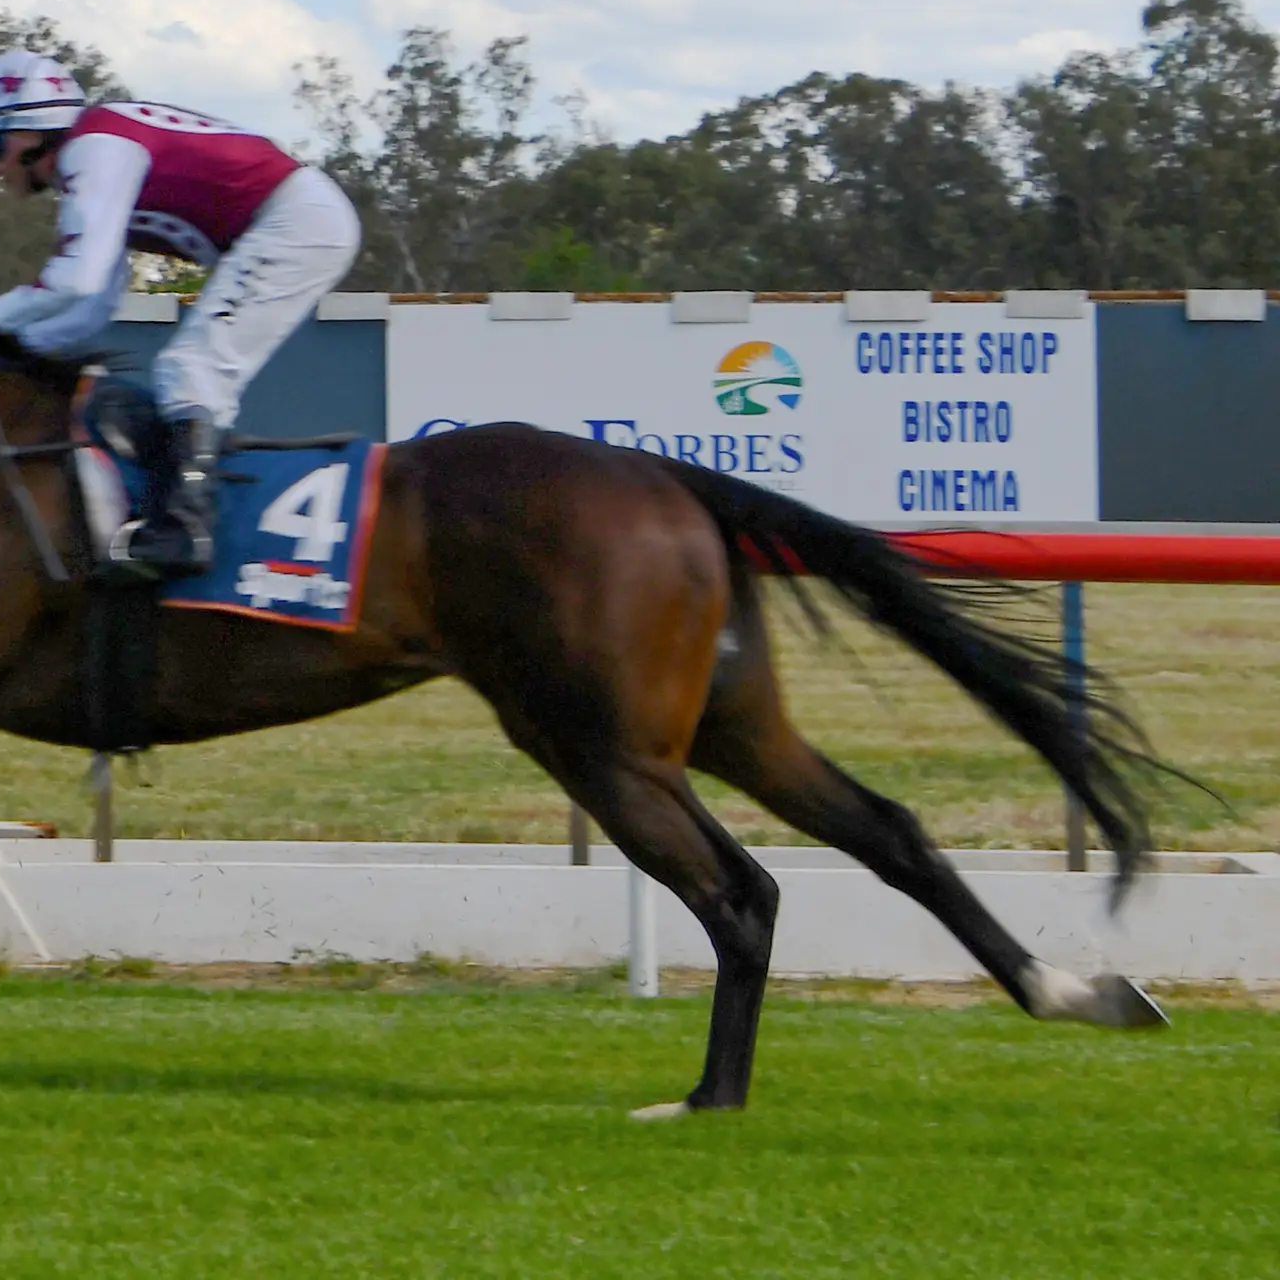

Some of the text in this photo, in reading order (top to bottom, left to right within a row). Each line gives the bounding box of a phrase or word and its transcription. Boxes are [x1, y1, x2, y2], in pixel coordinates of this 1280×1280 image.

[857, 332, 1059, 374] COFFEE SHOP
[902, 401, 1012, 442] BISTRO
[898, 470, 1020, 511] CINEMA
[260, 463, 350, 561] 4
